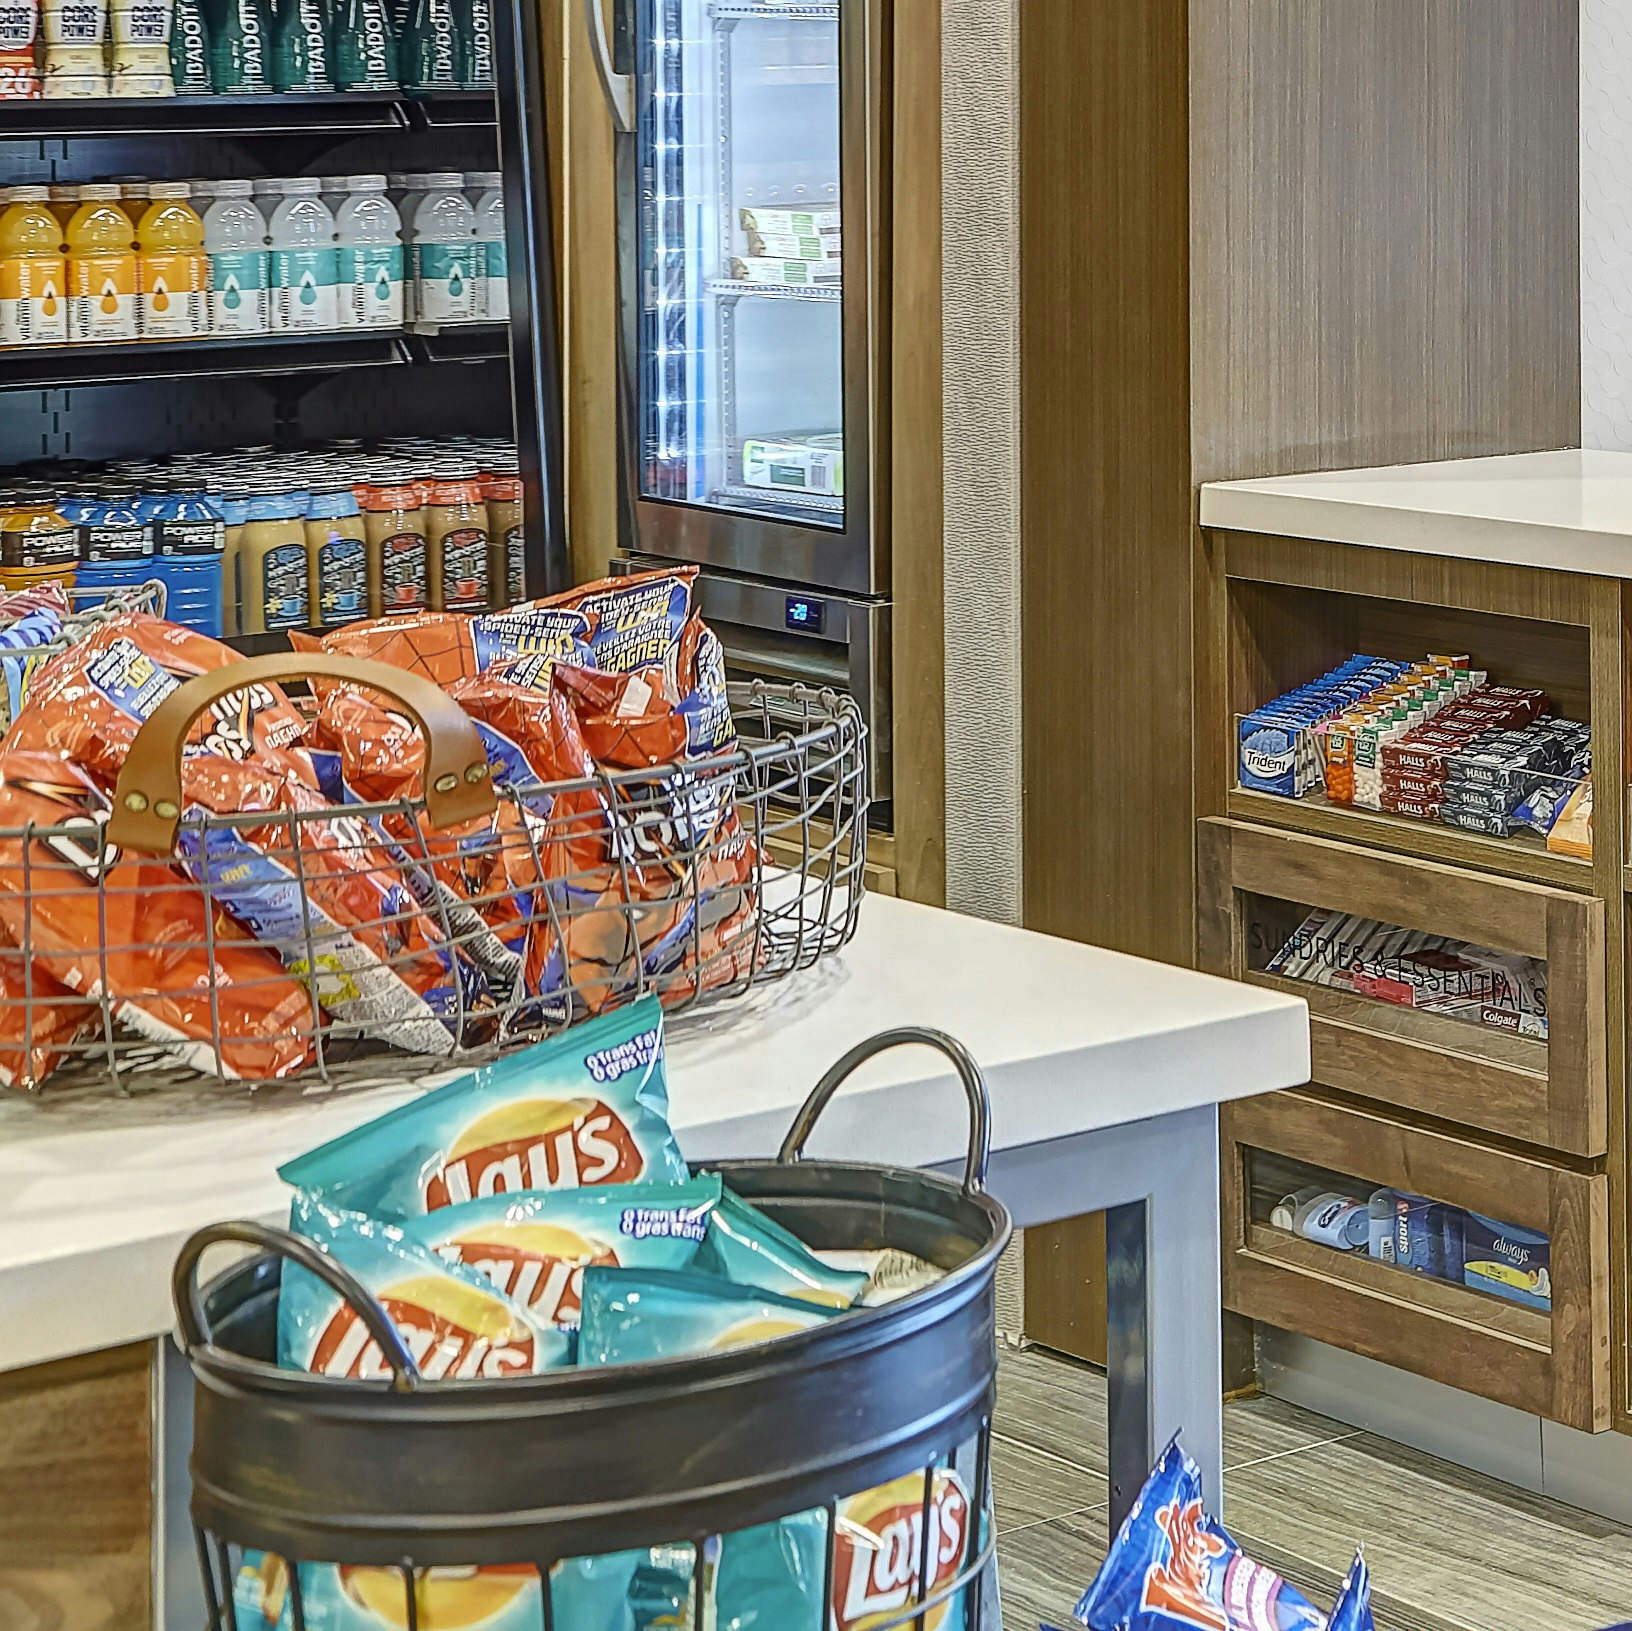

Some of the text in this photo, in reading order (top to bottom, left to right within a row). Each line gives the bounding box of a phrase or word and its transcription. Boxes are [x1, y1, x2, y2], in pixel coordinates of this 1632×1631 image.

[181, 5, 204, 75] BADOIT
[241, 4, 263, 74] BADOIT
[303, 4, 326, 72] BADOIT
[363, 2, 386, 71] BADOIT
[280, 253, 289, 328] vitaminwater
[355, 249, 366, 323] vitaminwater
[163, 526, 215, 536] POWER
[1247, 750, 1286, 772] Trident
[1399, 754, 1426, 768] HALLS
[1466, 767, 1494, 782] HALLS
[1399, 779, 1426, 794] HALLS
[1462, 792, 1490, 807] HALLS
[1397, 801, 1424, 816] HALLS
[1459, 814, 1486, 830] HALLS
[1250, 922, 1547, 1018] SUNDRIES & ESSENTIALS
[1482, 1009, 1518, 1028] Colgate
[1398, 1214, 1410, 1254] sport
[1493, 1236, 1531, 1265] always
[842, 1489, 963, 1623] Lay's
